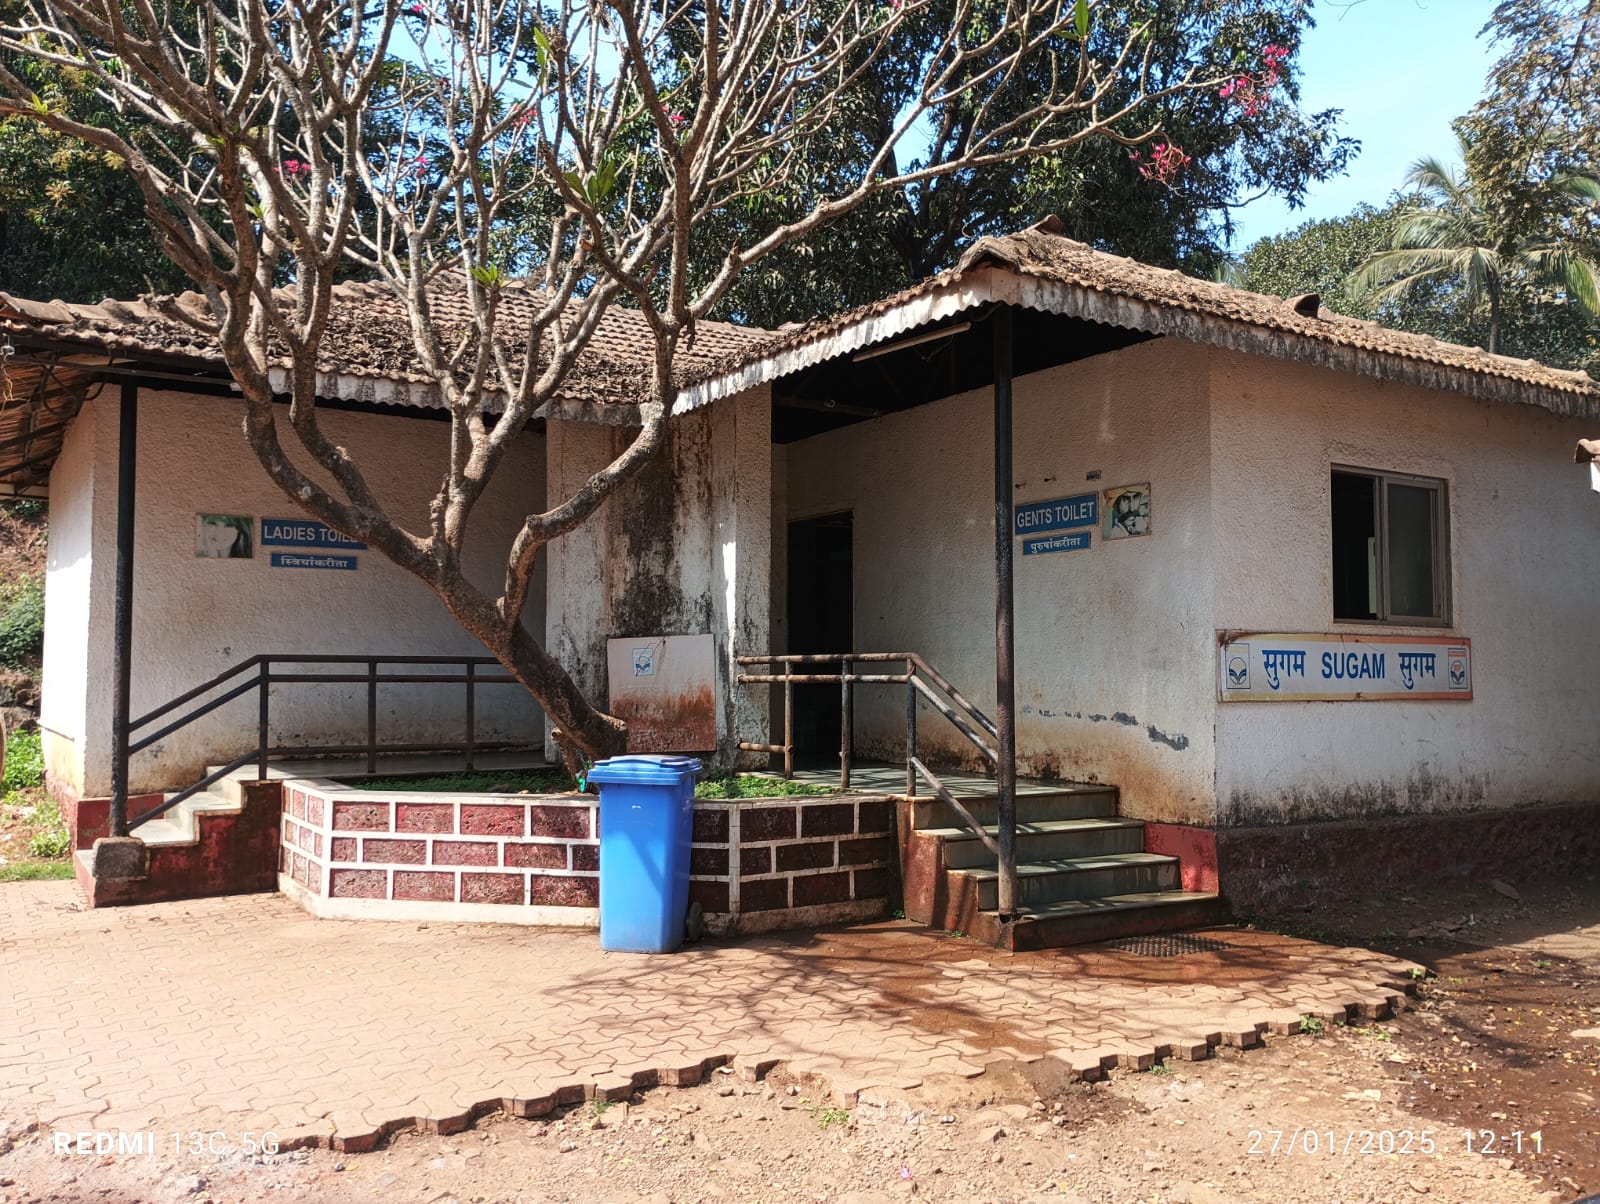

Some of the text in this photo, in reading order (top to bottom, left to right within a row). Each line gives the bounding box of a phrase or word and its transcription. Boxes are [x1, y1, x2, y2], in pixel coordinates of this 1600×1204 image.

[1016, 501, 1095, 528] GENTS TOILET
[264, 525, 316, 541] LADIES
[1261, 650, 1437, 690] सुगम SUGAM सुगम
